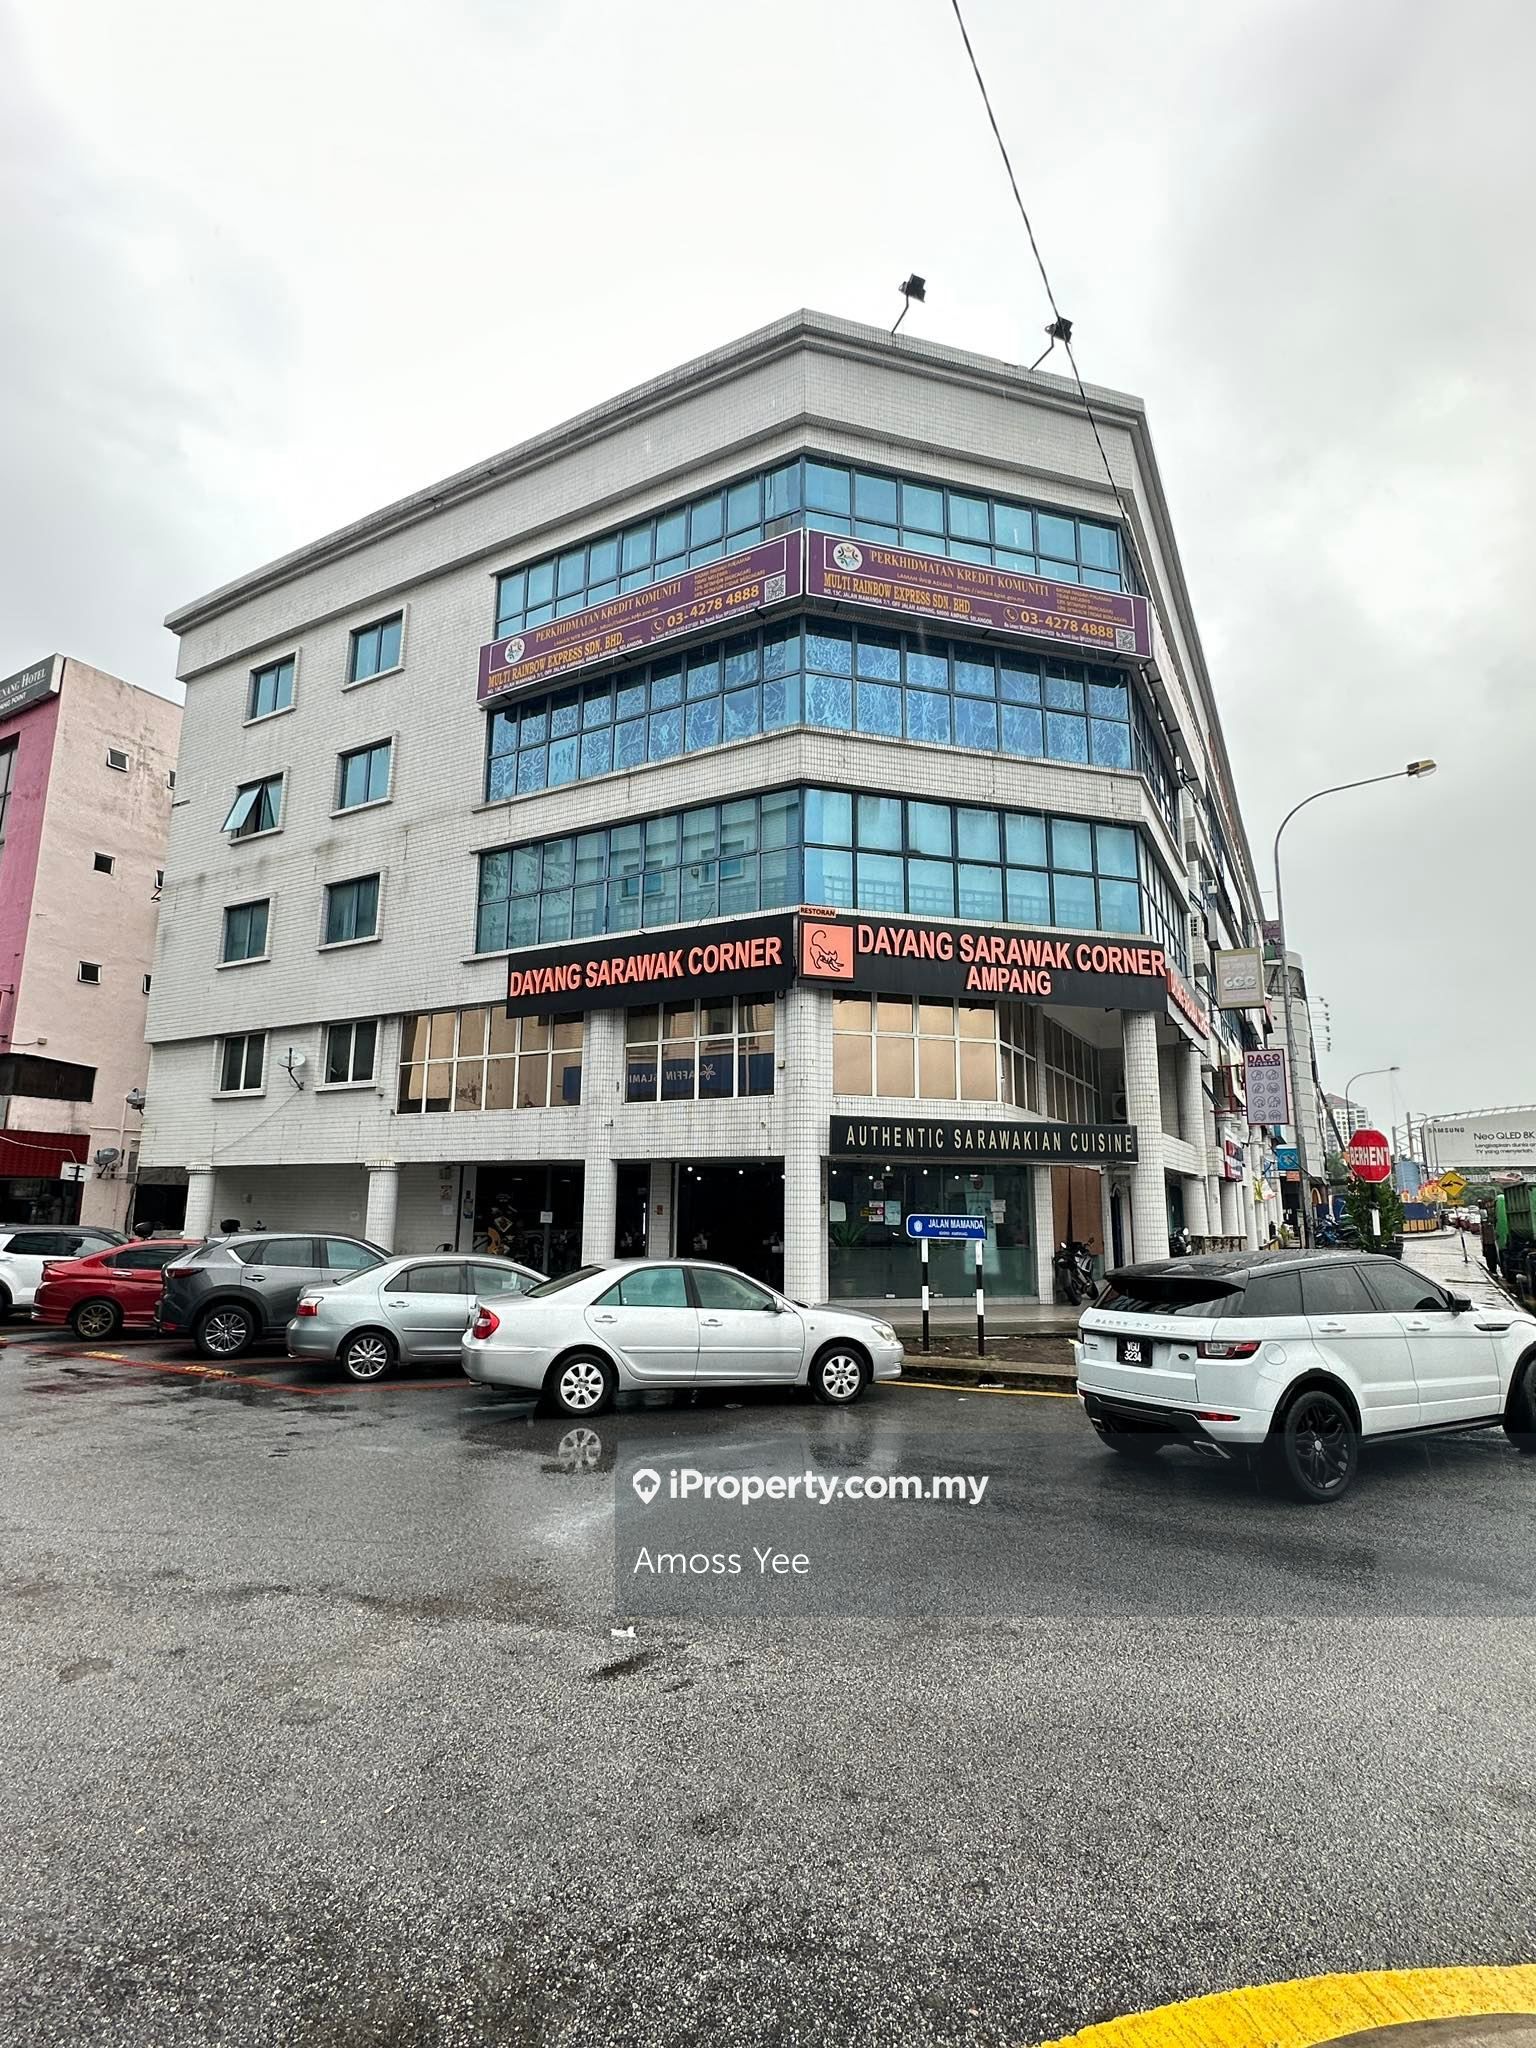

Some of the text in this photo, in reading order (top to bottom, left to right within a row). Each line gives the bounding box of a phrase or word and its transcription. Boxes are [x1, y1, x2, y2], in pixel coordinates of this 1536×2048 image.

[870, 549, 954, 578] PERKHIDMATAN
[956, 567, 995, 586] KREDIT
[998, 575, 1048, 596] KOMUNITI
[725, 583, 759, 607] 4888
[823, 572, 849, 591] MULTI
[853, 578, 890, 598] RAINBOW
[894, 586, 929, 606] EXPRESS
[953, 598, 972, 614] BHD.
[535, 610, 598, 644] PERKHIDMATAN
[601, 597, 633, 620] KREDIT
[635, 580, 681, 608] KOMUNITI
[1080, 621, 1113, 639] 4888
[488, 629, 624, 688] MULTI RAINBOW EXPRESS SDN. BHD.
[800, 907, 836, 916] RESTORAN
[857, 924, 1167, 977] DAYANG SARAWAK CORNER
[509, 936, 783, 998] DAYANG SARAWAK CORNER
[966, 966, 1053, 996] AMPANG
[846, 1125, 1133, 1154] AUTHENTIC SARAWAKIAN CUISINE
[1473, 1131, 1535, 1140] Neo QLED 8K
[928, 1218, 983, 1229] JALAN MAMANDA
